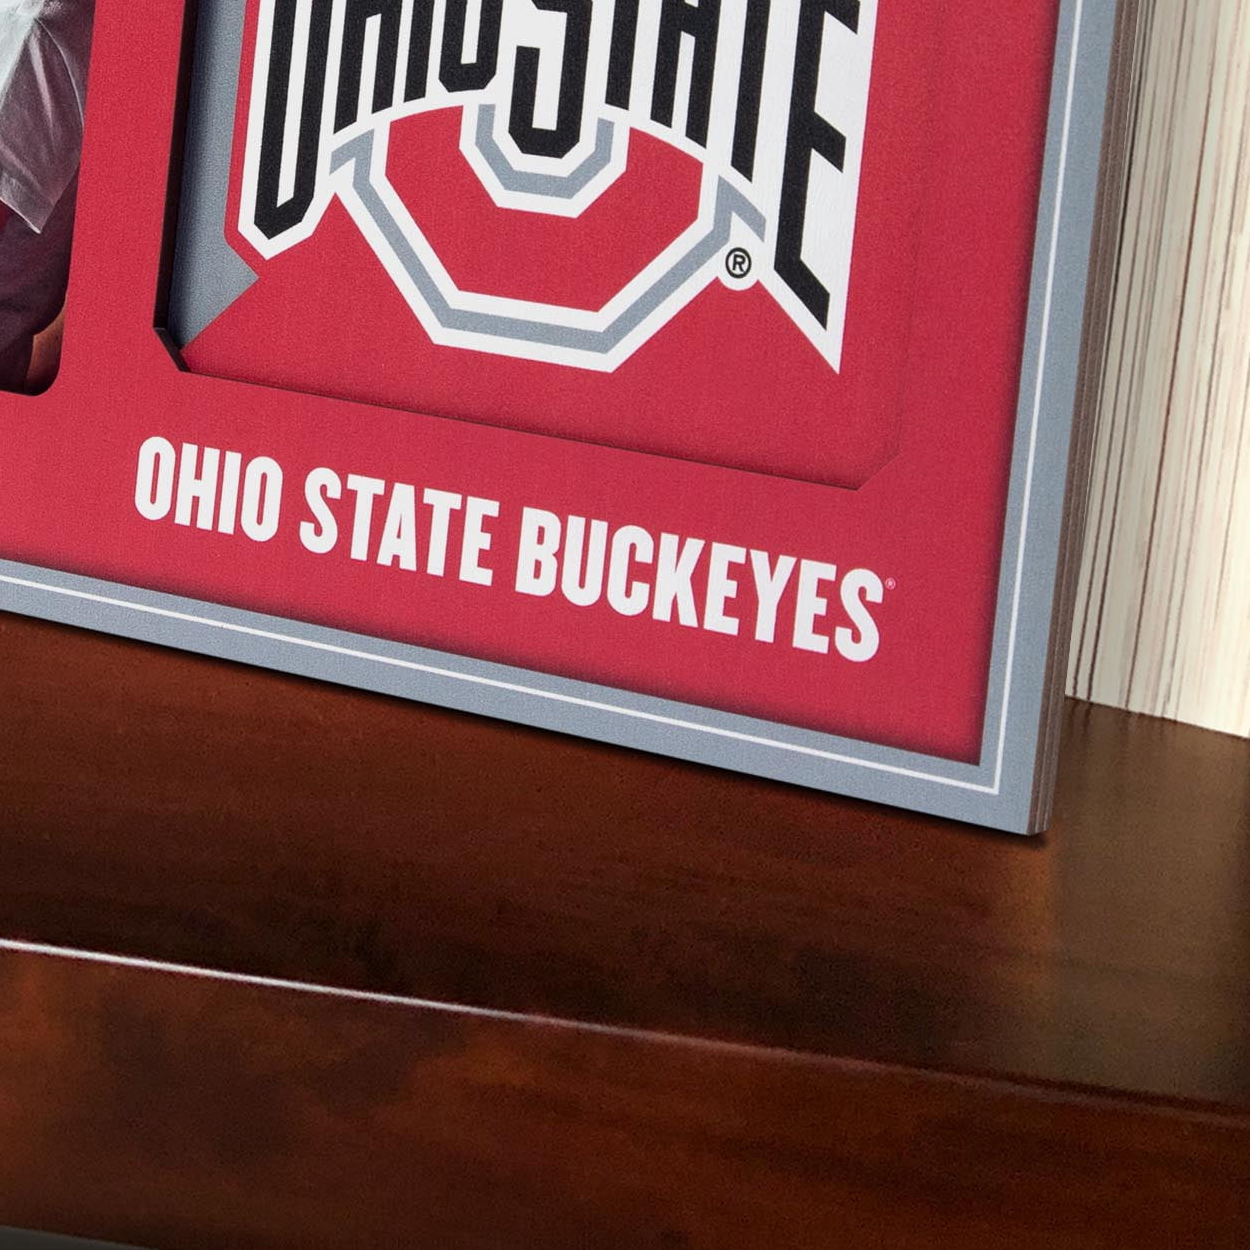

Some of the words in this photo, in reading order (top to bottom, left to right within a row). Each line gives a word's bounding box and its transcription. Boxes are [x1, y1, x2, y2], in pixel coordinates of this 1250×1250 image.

[134, 436, 284, 543] OHIO
[299, 467, 501, 586] STATE
[515, 507, 884, 664] BUCKEYES
